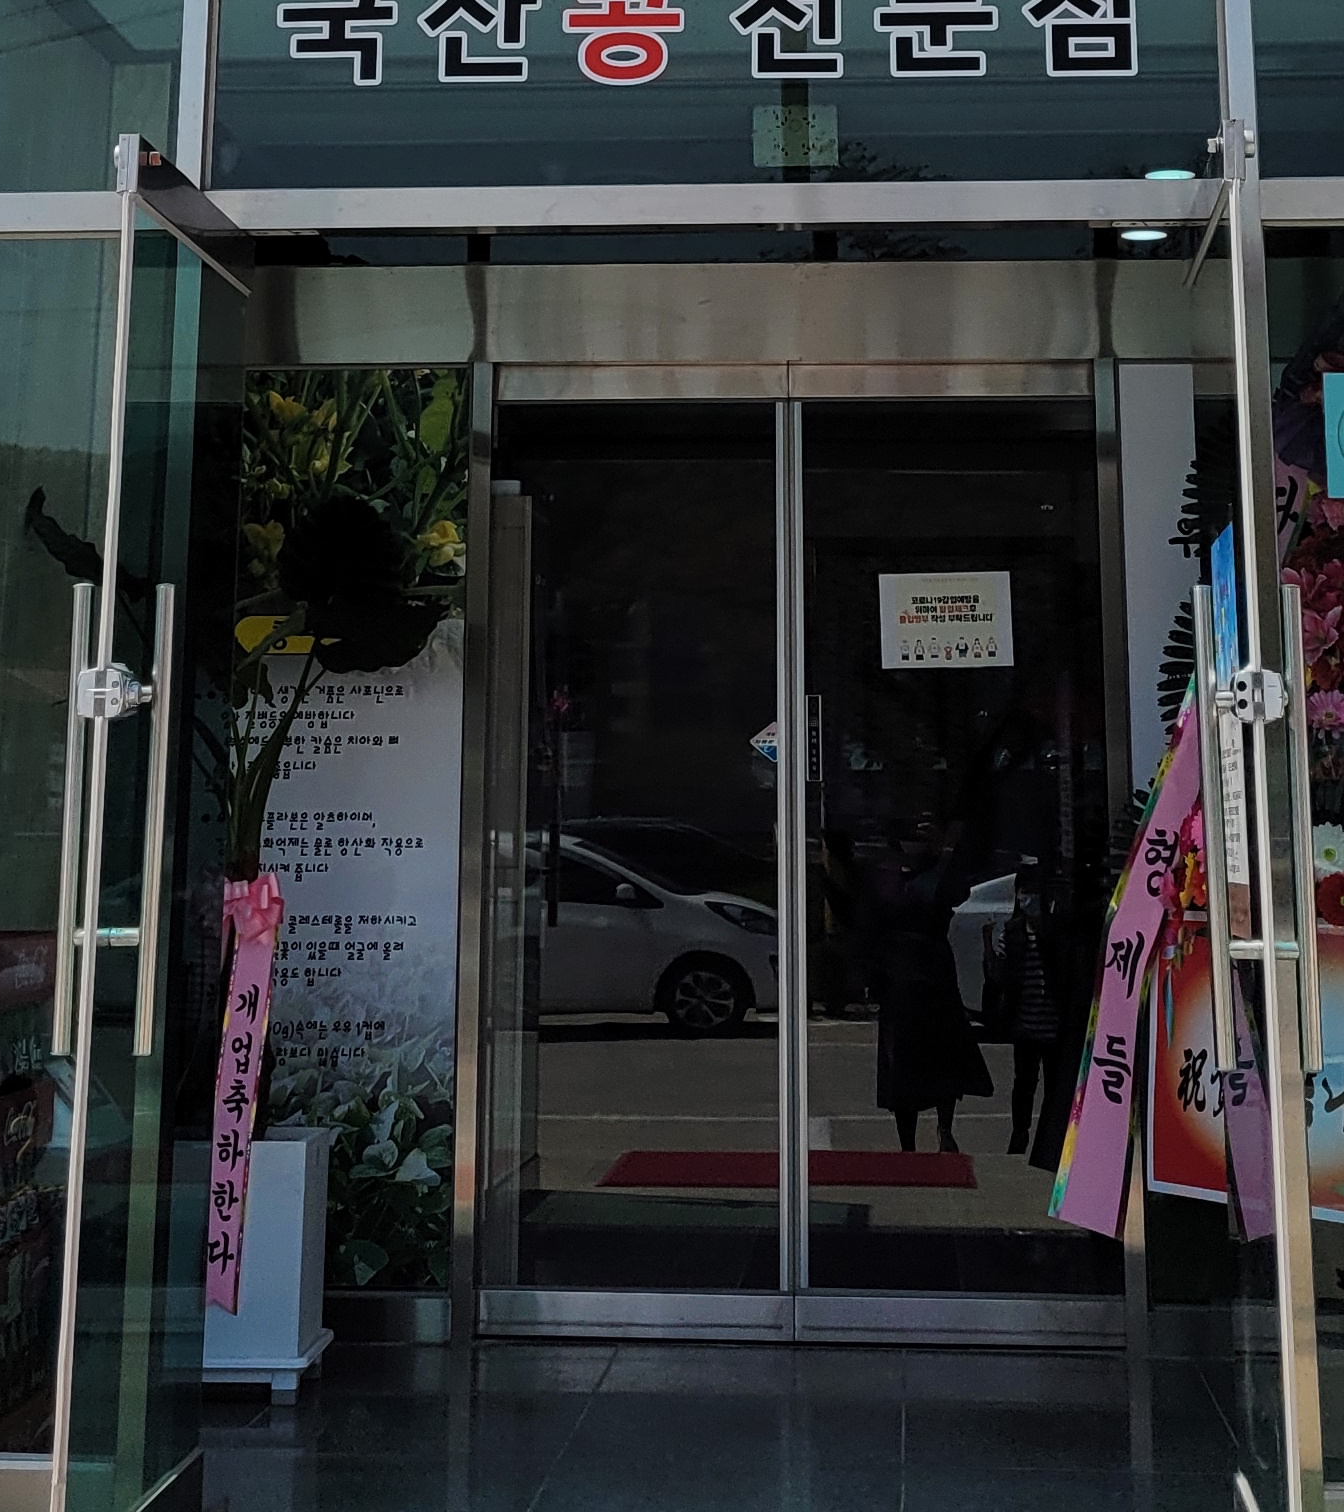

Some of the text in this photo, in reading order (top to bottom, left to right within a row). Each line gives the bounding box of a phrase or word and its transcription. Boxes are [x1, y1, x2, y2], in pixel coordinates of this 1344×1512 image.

[350, 684, 405, 705] 사포닌으로
[347, 735, 384, 747] 치아와
[261, 811, 309, 831] 플라본은
[259, 837, 310, 857] 화억제는
[381, 837, 424, 857] 작용으로
[357, 914, 418, 927] 저하시키고
[304, 967, 342, 987] 합니다
